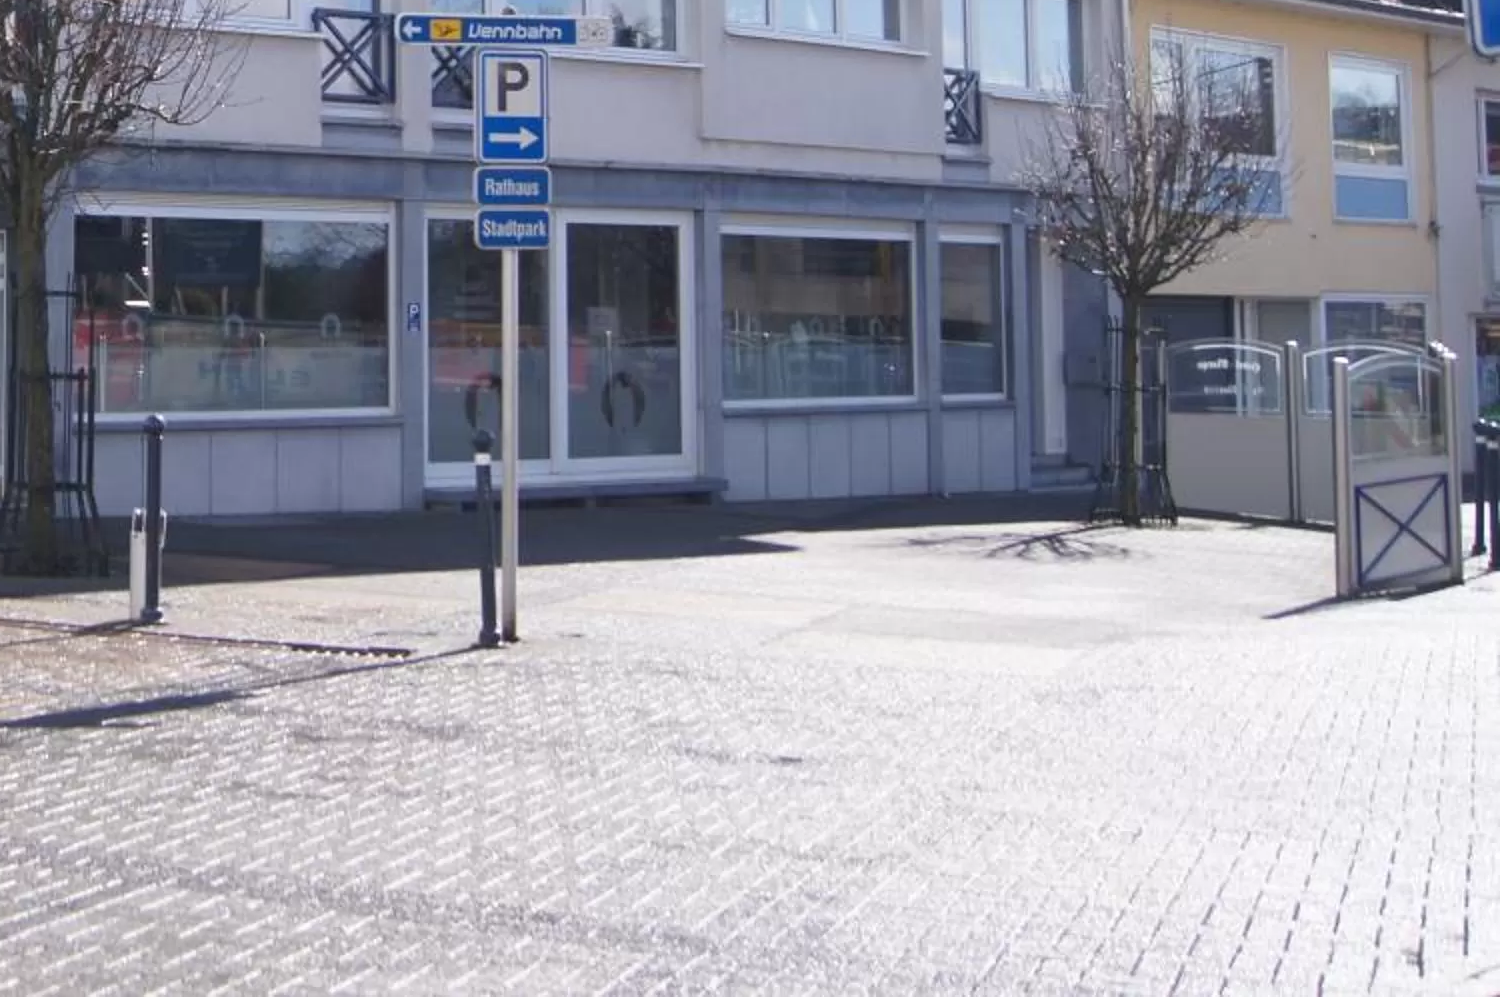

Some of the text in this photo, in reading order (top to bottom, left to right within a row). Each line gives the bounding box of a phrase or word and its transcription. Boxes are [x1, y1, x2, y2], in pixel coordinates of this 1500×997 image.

[497, 61, 530, 113] P
[484, 178, 540, 197] Rathaus
[481, 218, 547, 242] Stadtpark
